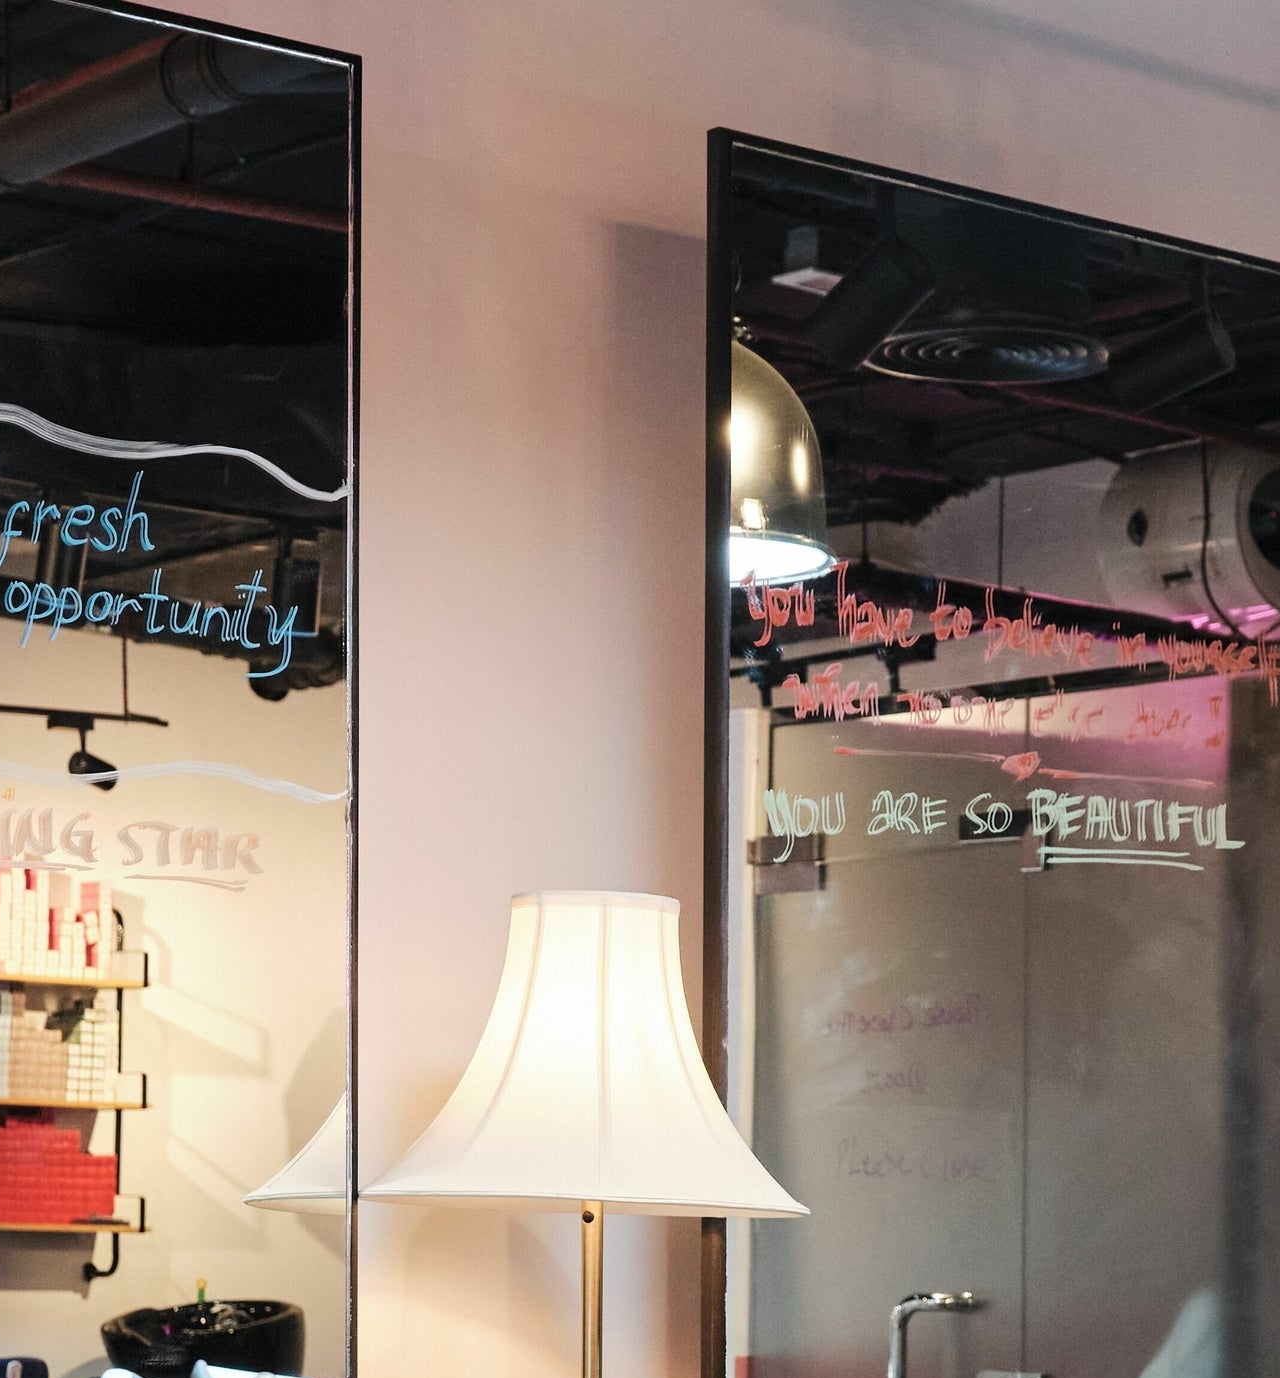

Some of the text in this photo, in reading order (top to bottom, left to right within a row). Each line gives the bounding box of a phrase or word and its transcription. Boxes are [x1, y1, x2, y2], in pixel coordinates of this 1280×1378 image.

[5, 568, 300, 678] opportunity
[830, 560, 920, 648] have
[930, 580, 971, 641] to
[118, 820, 264, 874] STAR
[965, 792, 1012, 834] SO
[1026, 787, 1245, 850] BEAUTIFUL
